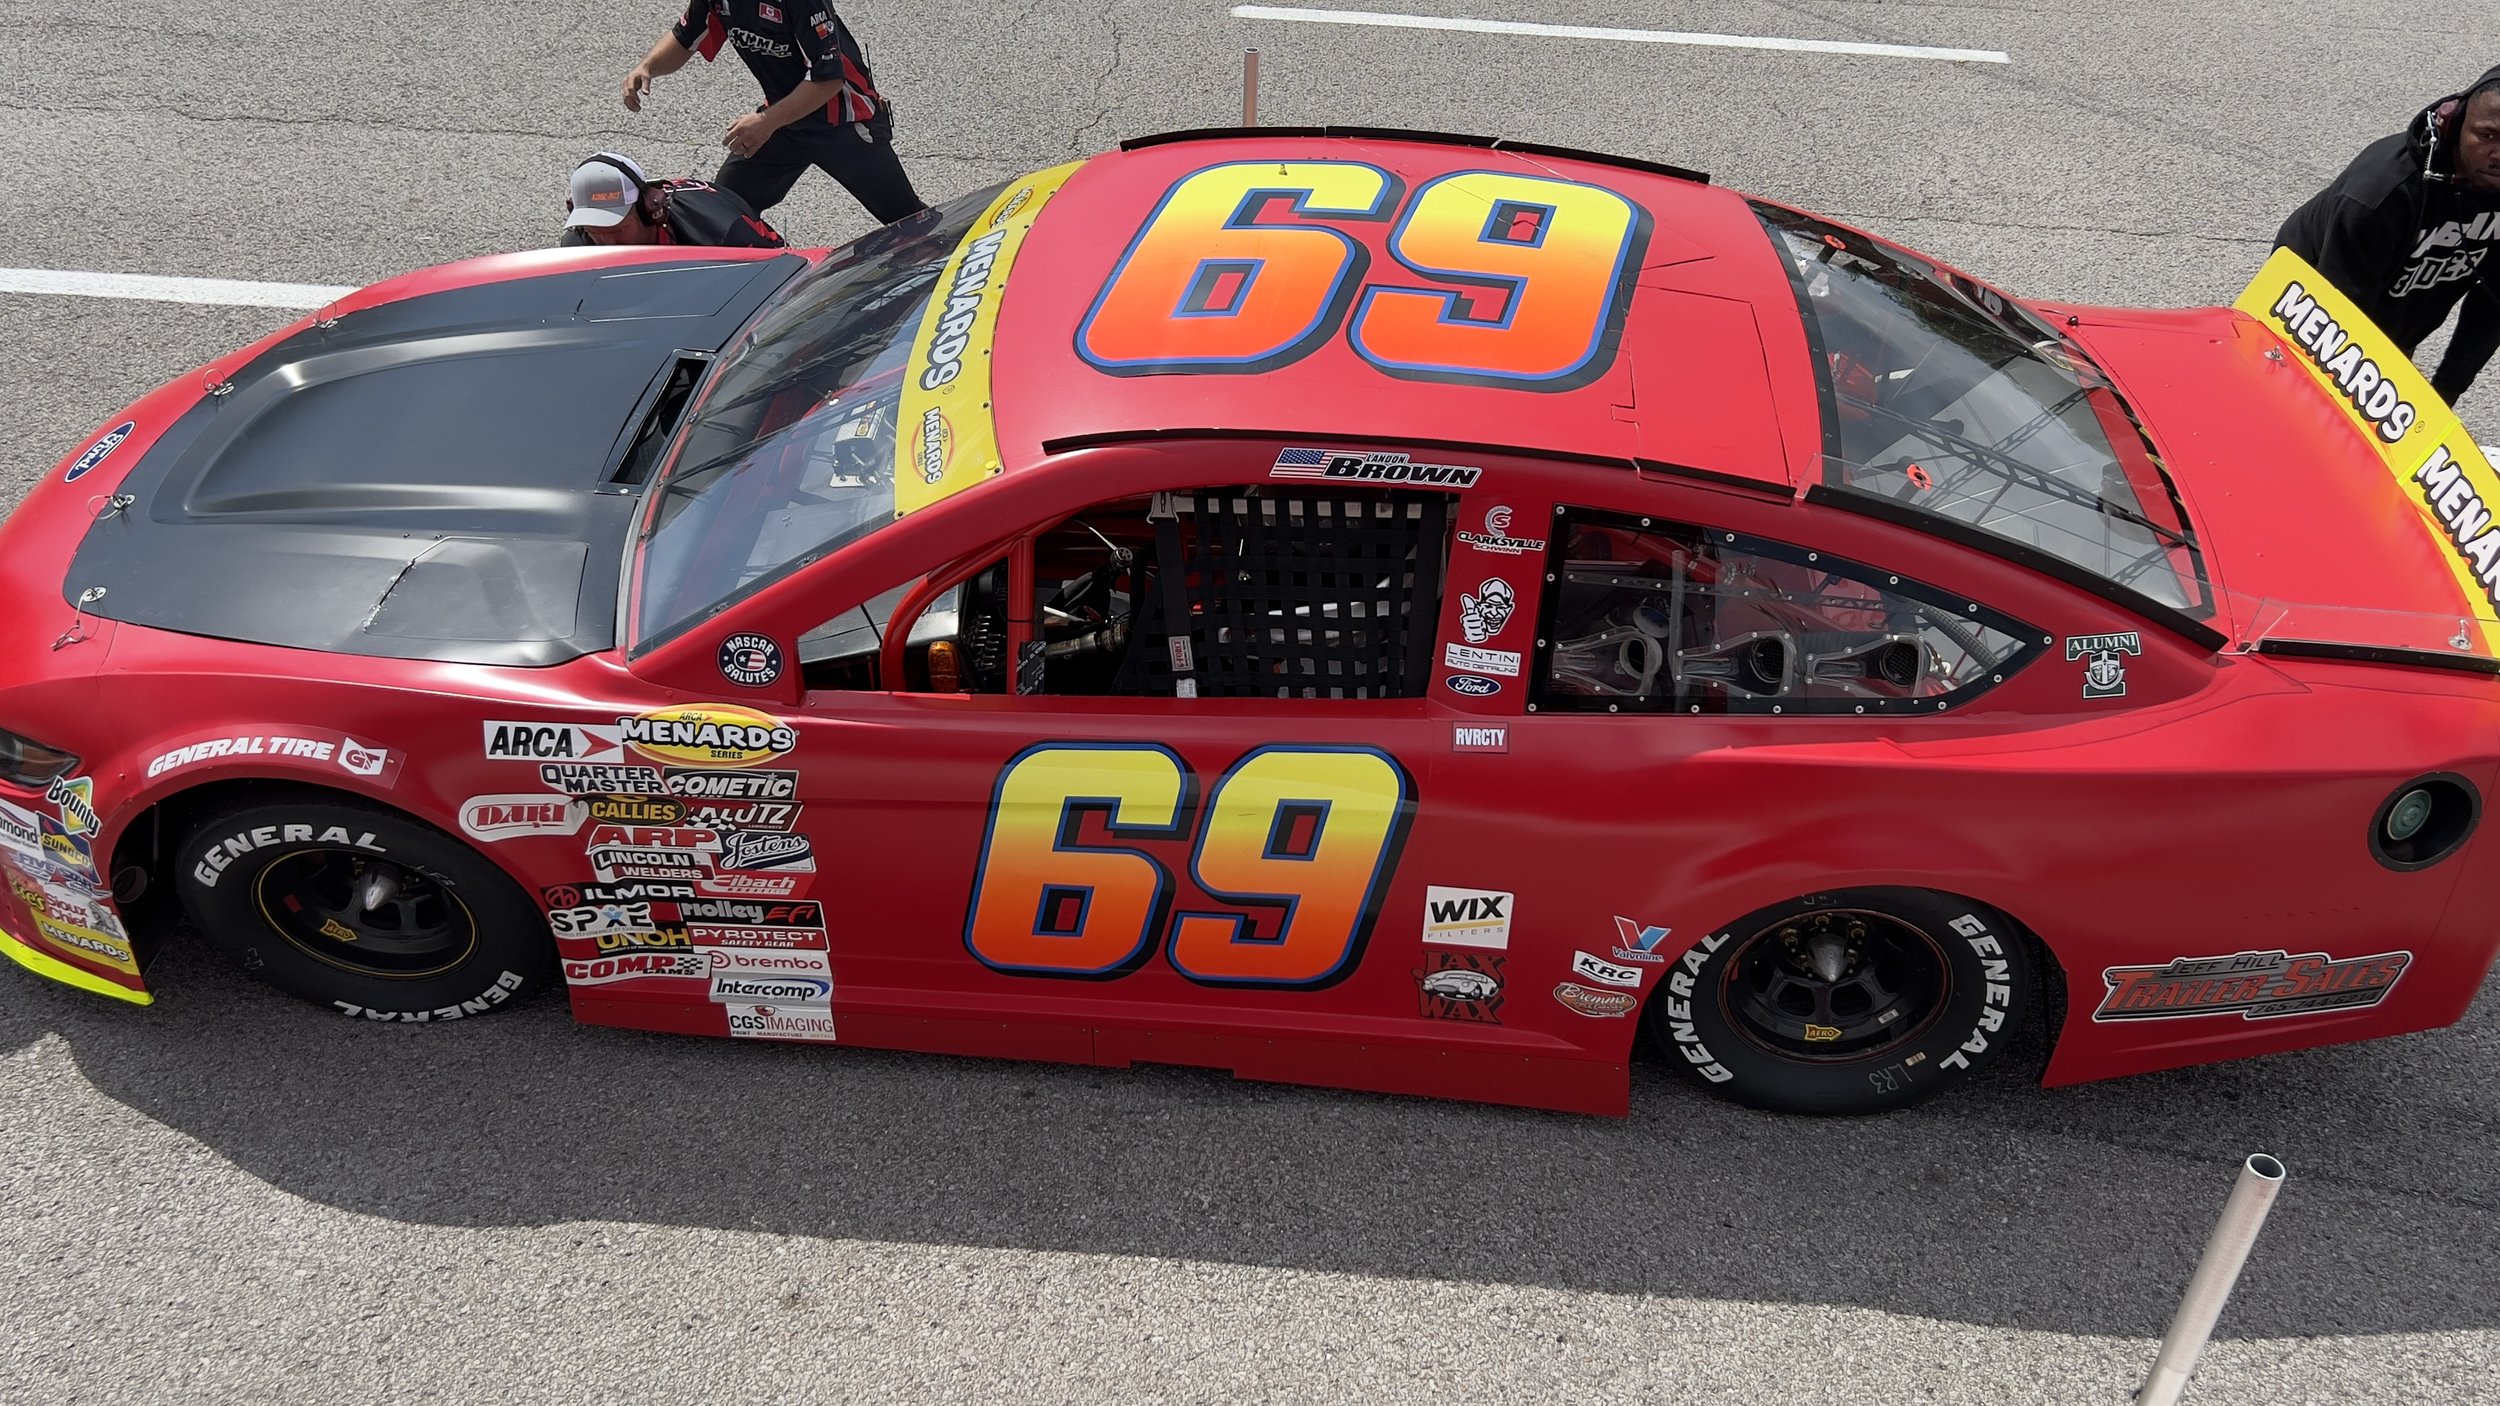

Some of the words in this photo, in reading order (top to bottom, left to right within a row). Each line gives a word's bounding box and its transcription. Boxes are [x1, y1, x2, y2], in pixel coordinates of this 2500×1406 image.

[1073, 160, 1655, 393] 69
[919, 229, 1007, 391] MENARDS
[2270, 281, 2416, 443] MENARDS
[75, 433, 124, 471] Ford
[923, 406, 943, 484] MENARDS
[1366, 453, 1408, 464] LANDON
[1324, 457, 1479, 485] BROWN
[1458, 532, 1544, 550] CLARKSVILLE
[1474, 543, 1521, 554] SCHWINN
[726, 637, 775, 656] NASCAR
[2070, 634, 2136, 651] ALUMNI
[1447, 658, 1470, 668] AUTO
[1448, 645, 1519, 663] LENTINI
[724, 663, 776, 683] SALUTES
[1455, 677, 1490, 693] Ford
[679, 712, 703, 721] ARCA
[489, 725, 573, 757] ARCA
[618, 717, 795, 753] MENARDS
[1455, 728, 1506, 746] RVRCTY
[148, 737, 264, 778] GENERAL
[269, 737, 335, 760] TIRE
[711, 750, 743, 759] SERIES
[542, 764, 655, 784] QUARTER
[564, 778, 665, 793] MASTER
[667, 775, 793, 797] COMETIC
[48, 777, 100, 836] Bounty
[592, 801, 676, 820] CALLIES
[591, 827, 716, 848] ARP
[43, 834, 91, 866] SUNOCO
[194, 824, 386, 887] GENERAL
[598, 850, 690, 868] LINCOLN
[721, 832, 808, 869] Jostens
[622, 865, 703, 879] WELDERS
[961, 739, 1419, 991] 69
[585, 884, 695, 900] ILMOR
[701, 874, 795, 893] Eibach
[45, 893, 88, 917] Sioux
[766, 905, 816, 923] EFI
[1430, 896, 1504, 923] WIX
[51, 908, 88, 928] Chief
[40, 920, 130, 962] MENARDS
[596, 928, 692, 949] UNOH
[693, 928, 817, 941] PYROTECT
[1427, 926, 1504, 939] FILTERS
[721, 938, 762, 947] SAFETY
[764, 940, 794, 948] GEAR
[735, 955, 823, 970] brembo
[1612, 946, 1662, 961] Valvoline
[566, 955, 676, 979] COMP
[643, 967, 696, 975] CAMS
[1580, 957, 1637, 979] KRC
[2170, 960, 2226, 975] JEFF
[2230, 955, 2280, 970] HILL
[716, 978, 815, 1001] Intercomp
[1939, 914, 2012, 1070] GENERAL
[2105, 970, 2270, 1010] TRAILER
[2272, 956, 2405, 998] SALES
[334, 970, 525, 1023] GENERAL
[1416, 985, 1505, 1025] WAX
[1667, 932, 1734, 1083] GENERAL
